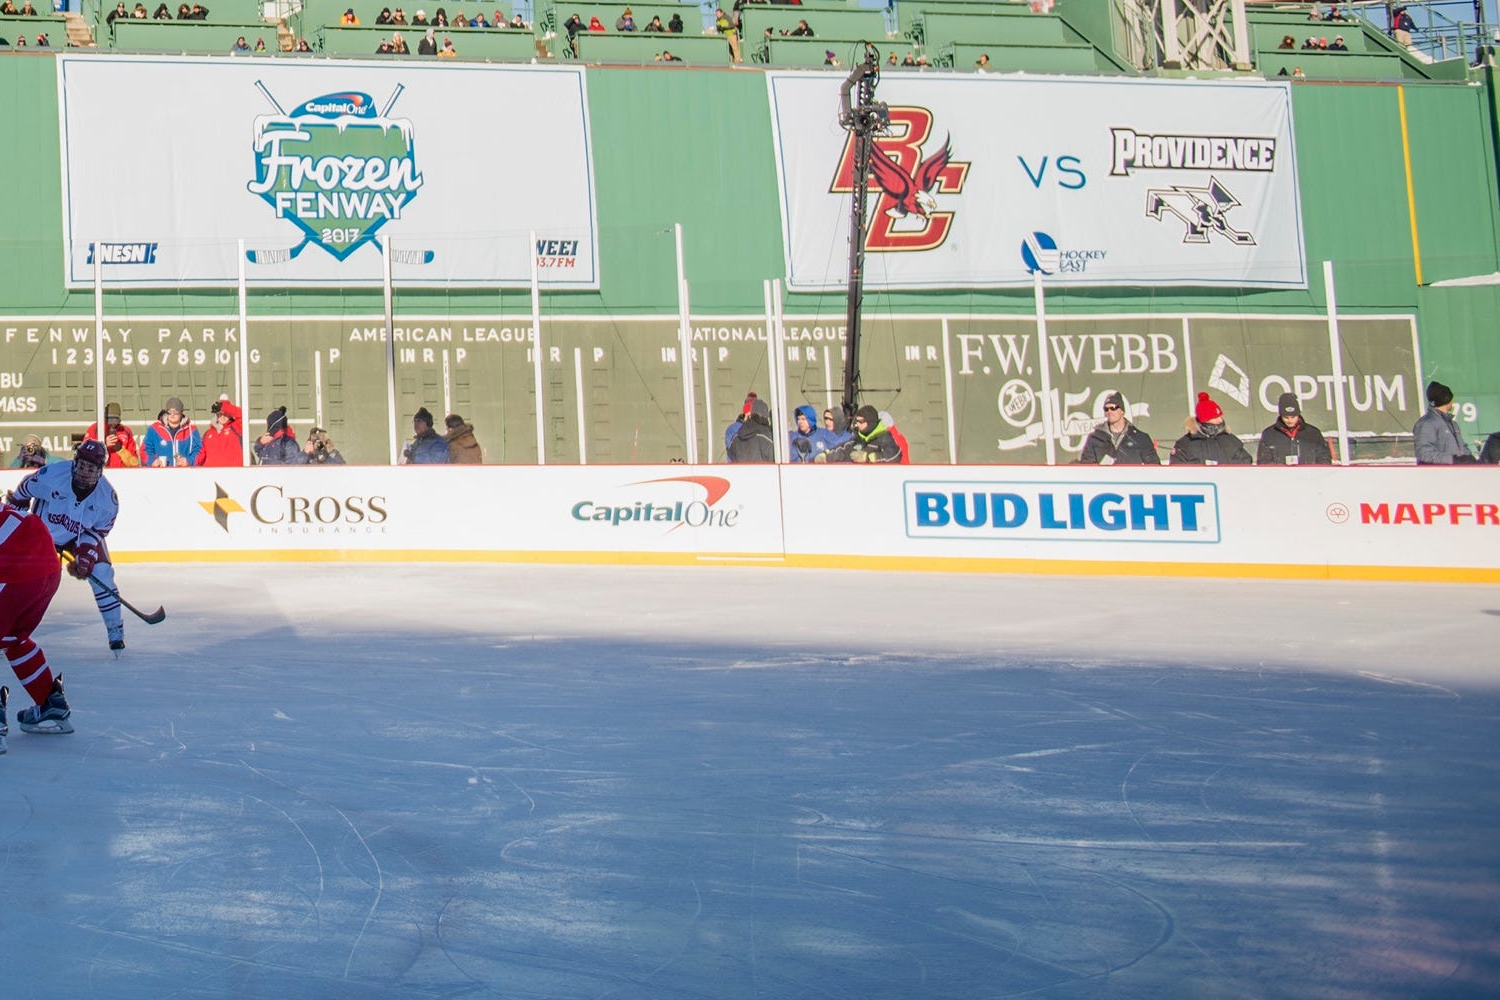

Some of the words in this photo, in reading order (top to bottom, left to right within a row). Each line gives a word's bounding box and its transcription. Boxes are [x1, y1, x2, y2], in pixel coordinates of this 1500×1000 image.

[246, 130, 424, 194] Frozen
[1017, 155, 1087, 189] VS
[275, 192, 406, 219] FENWAY
[322, 228, 360, 243] 2017
[100, 244, 146, 262] NESN
[1058, 250, 1107, 260] HOCKEY
[1058, 260, 1088, 273] EAST
[5, 329, 132, 342] FENWAY
[158, 328, 236, 342] PARK
[350, 328, 452, 342] AMERICAN
[463, 328, 535, 341] LEAGUE
[783, 327, 848, 340] LEAGUE
[52, 349, 57, 364] 1
[66, 349, 77, 364] 2
[83, 349, 94, 364] 3
[105, 349, 117, 364] 4
[122, 349, 133, 364] 5
[137, 349, 149, 364] 6
[160, 349, 170, 364] 7
[177, 349, 189, 364] 8
[194, 349, 206, 364] 9
[215, 349, 230, 364] 10
[250, 350, 260, 363] G
[330, 349, 340, 363] P
[401, 349, 415, 362] IN
[424, 348, 434, 362] R
[457, 348, 467, 362] P
[550, 347, 561, 362] R
[593, 347, 603, 362] P
[661, 347, 675, 361] IN
[719, 347, 728, 361] P
[788, 346, 800, 361] IN
[806, 346, 816, 361] R
[905, 345, 919, 360] IN
[927, 345, 937, 360] R
[956, 334, 1032, 375] F.W.
[1049, 334, 1179, 374] WEBB
[1, 373, 23, 388] BU
[1259, 374, 1406, 412] OPTUM
[41, 436, 72, 451] ALL
[915, 492, 1028, 527] BUD
[1039, 494, 1204, 531] LIGHT
[258, 526, 387, 534] INSURANCE
